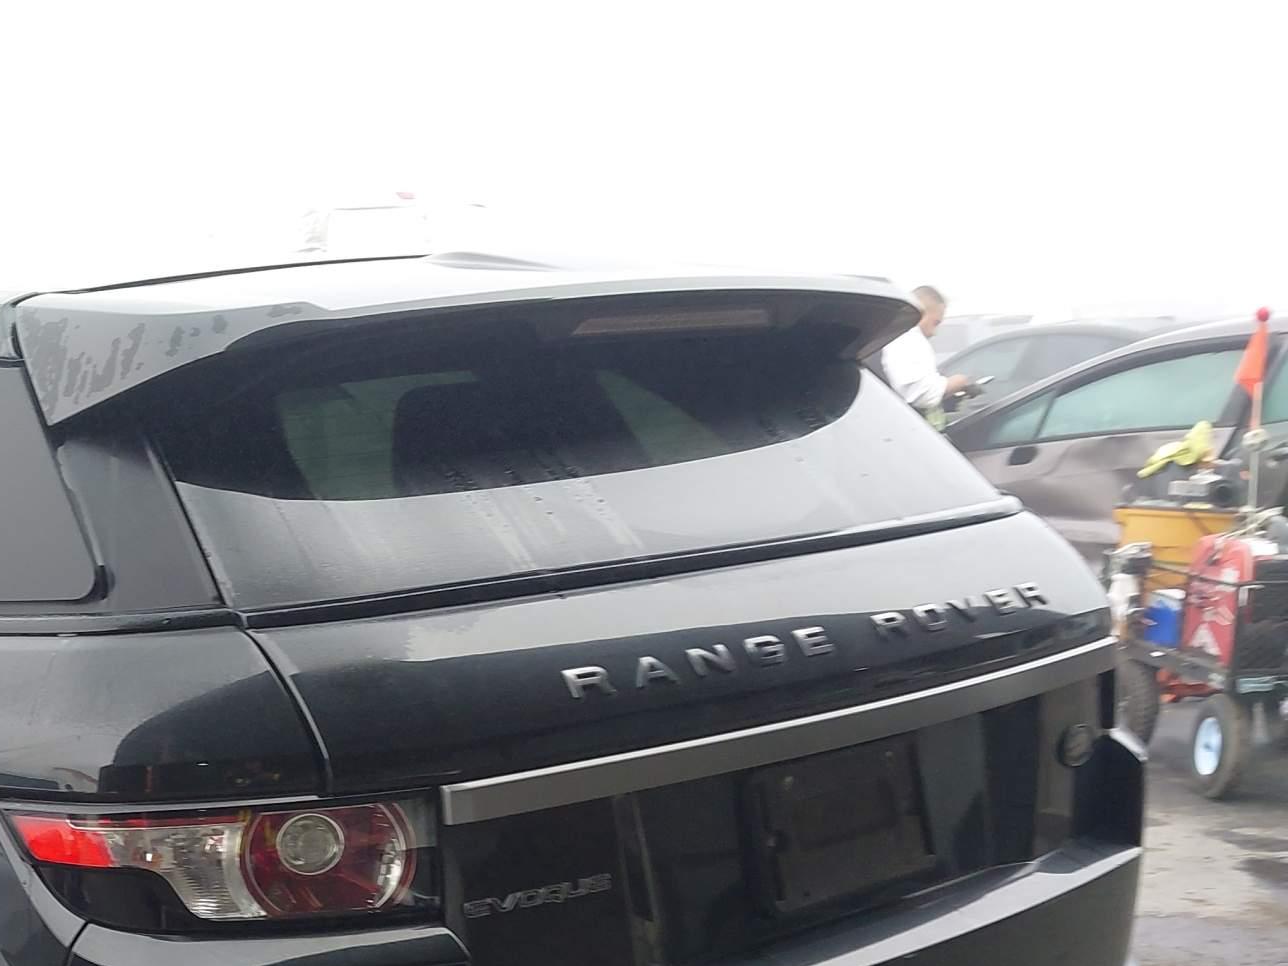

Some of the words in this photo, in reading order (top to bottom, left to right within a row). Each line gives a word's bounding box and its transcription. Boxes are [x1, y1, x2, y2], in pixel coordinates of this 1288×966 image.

[560, 625, 837, 699] RANGE
[869, 582, 1048, 642] ROVER
[463, 873, 613, 918] EVOQUE
